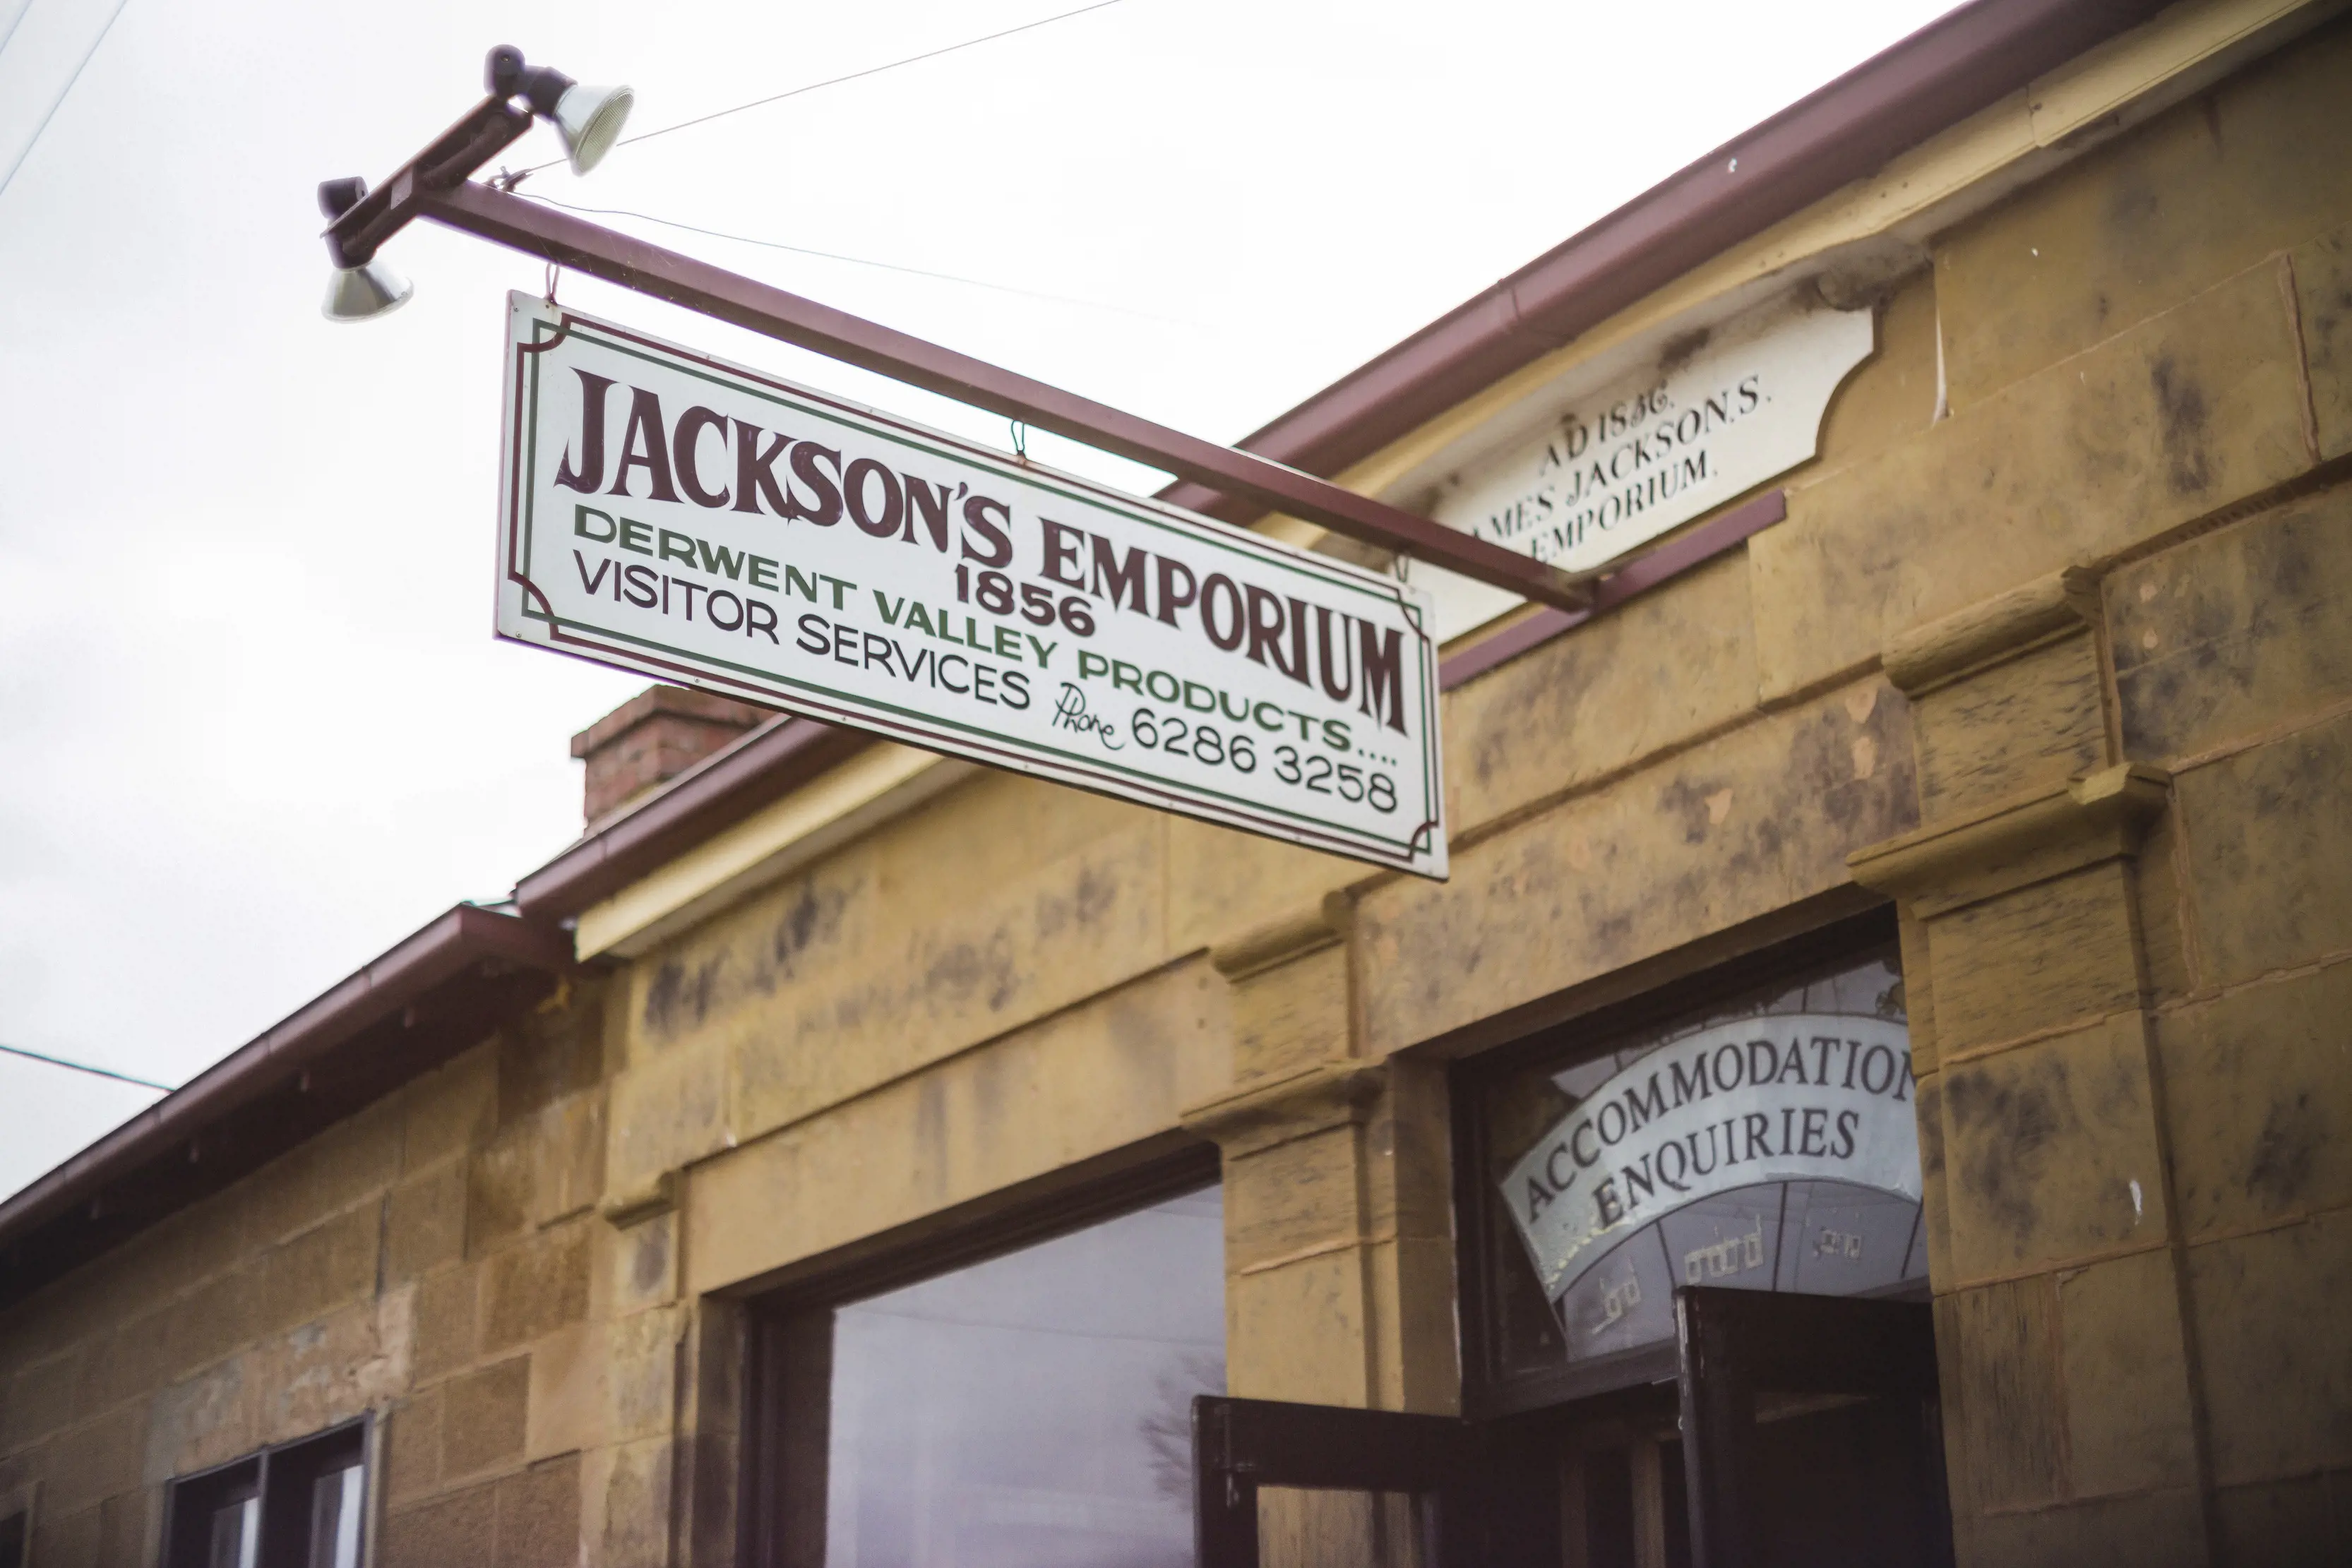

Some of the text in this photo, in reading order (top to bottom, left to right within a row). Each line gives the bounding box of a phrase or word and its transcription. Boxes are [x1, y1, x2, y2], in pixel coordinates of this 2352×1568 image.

[553, 366, 1409, 739] JACKSON'S EMPORIUM
[574, 503, 857, 611] DERWENT
[873, 589, 1058, 669] VALLEY
[954, 563, 1096, 638] 1856
[573, 549, 1397, 814] VISITOR SERVICES Phone 6286 3258
[1591, 1108, 1861, 1231] ENQUIRIES
